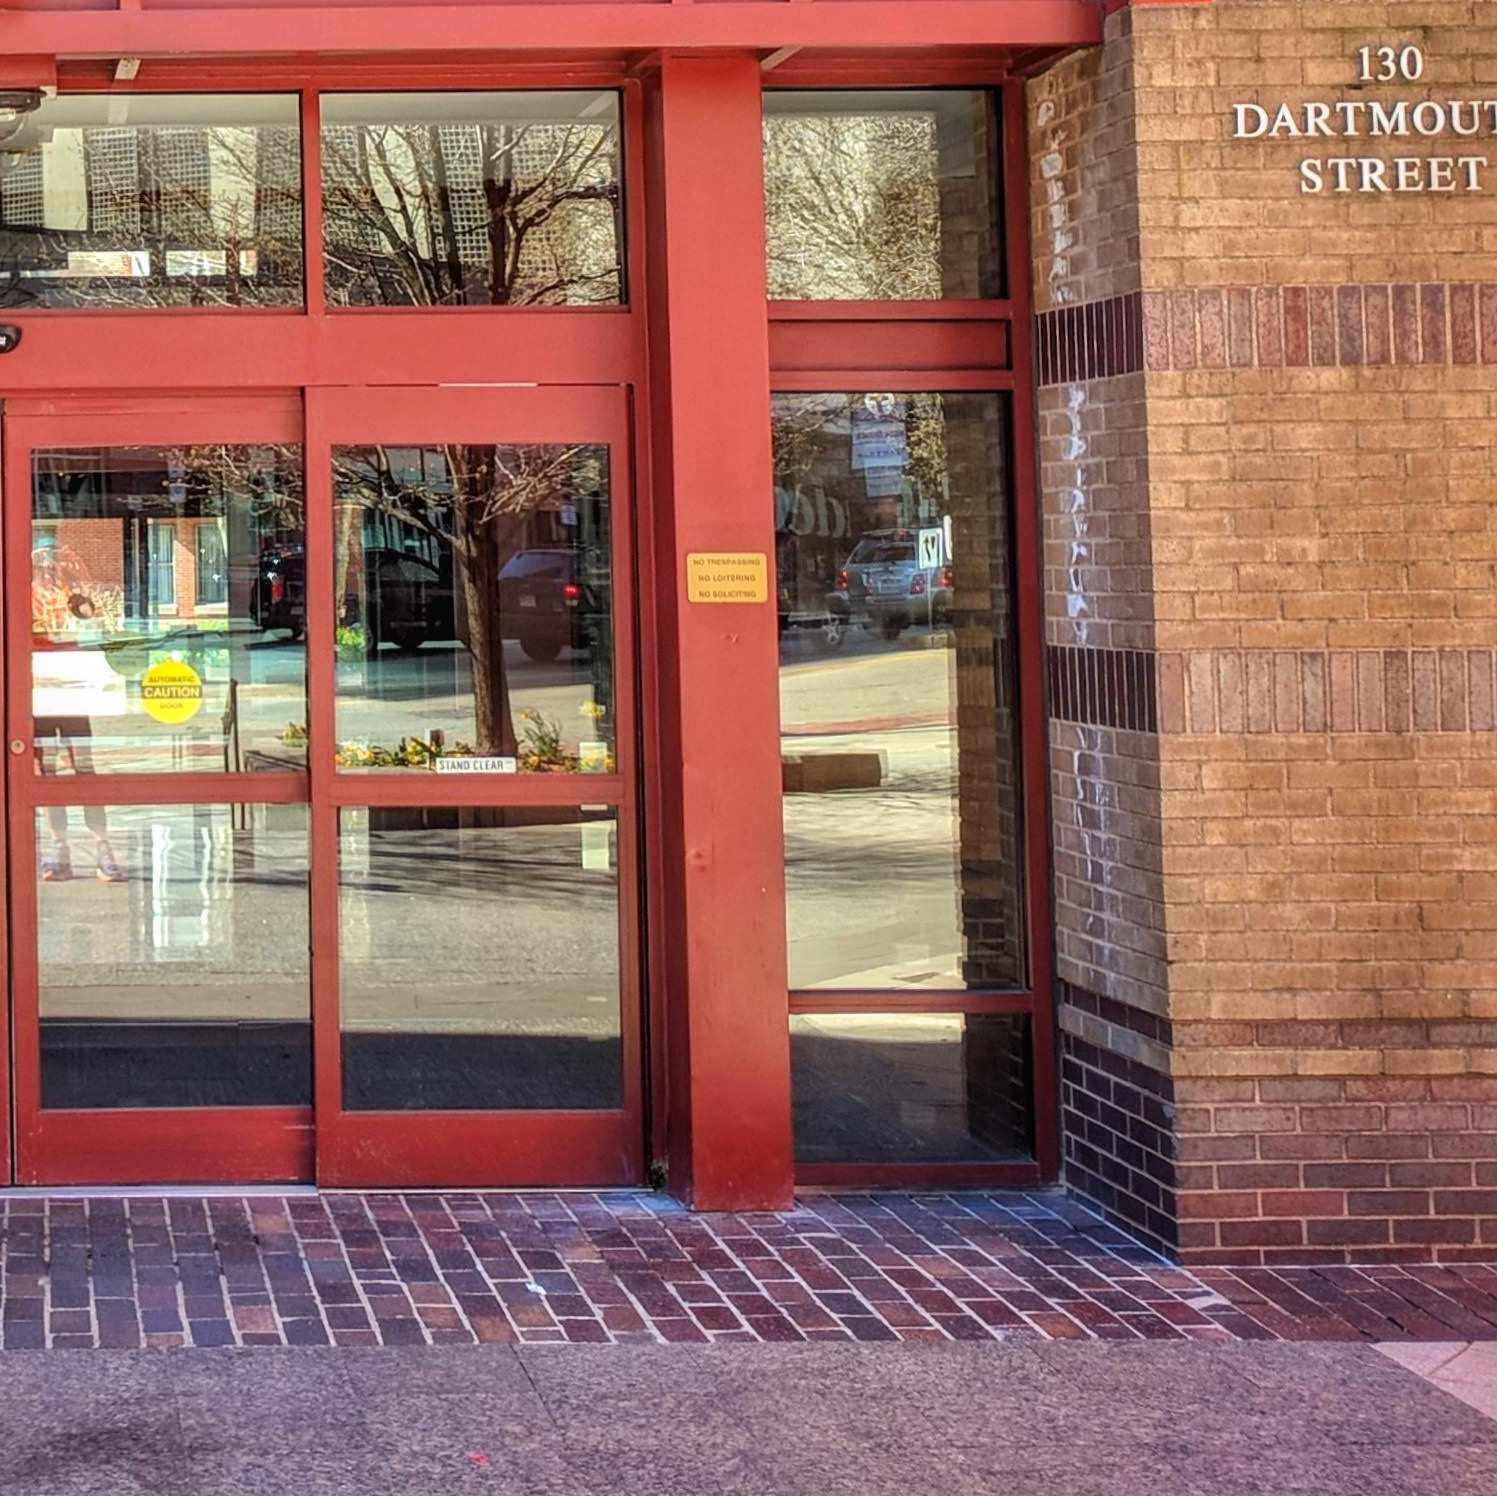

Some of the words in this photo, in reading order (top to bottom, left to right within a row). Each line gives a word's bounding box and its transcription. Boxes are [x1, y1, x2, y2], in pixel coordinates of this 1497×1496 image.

[1358, 45, 1425, 82] 130
[1299, 156, 1488, 194] STREET
[692, 558, 705, 566] NO
[707, 558, 760, 566] TRESPASSING
[698, 574, 711, 582] NO
[712, 574, 756, 582] LOITERING
[698, 590, 711, 598] NO
[712, 590, 756, 598] SOLICITING
[148, 675, 195, 683] AUTOMATIC
[144, 686, 200, 697] CAUTION
[439, 759, 471, 770] STAND
[472, 759, 504, 770] CLEAR
